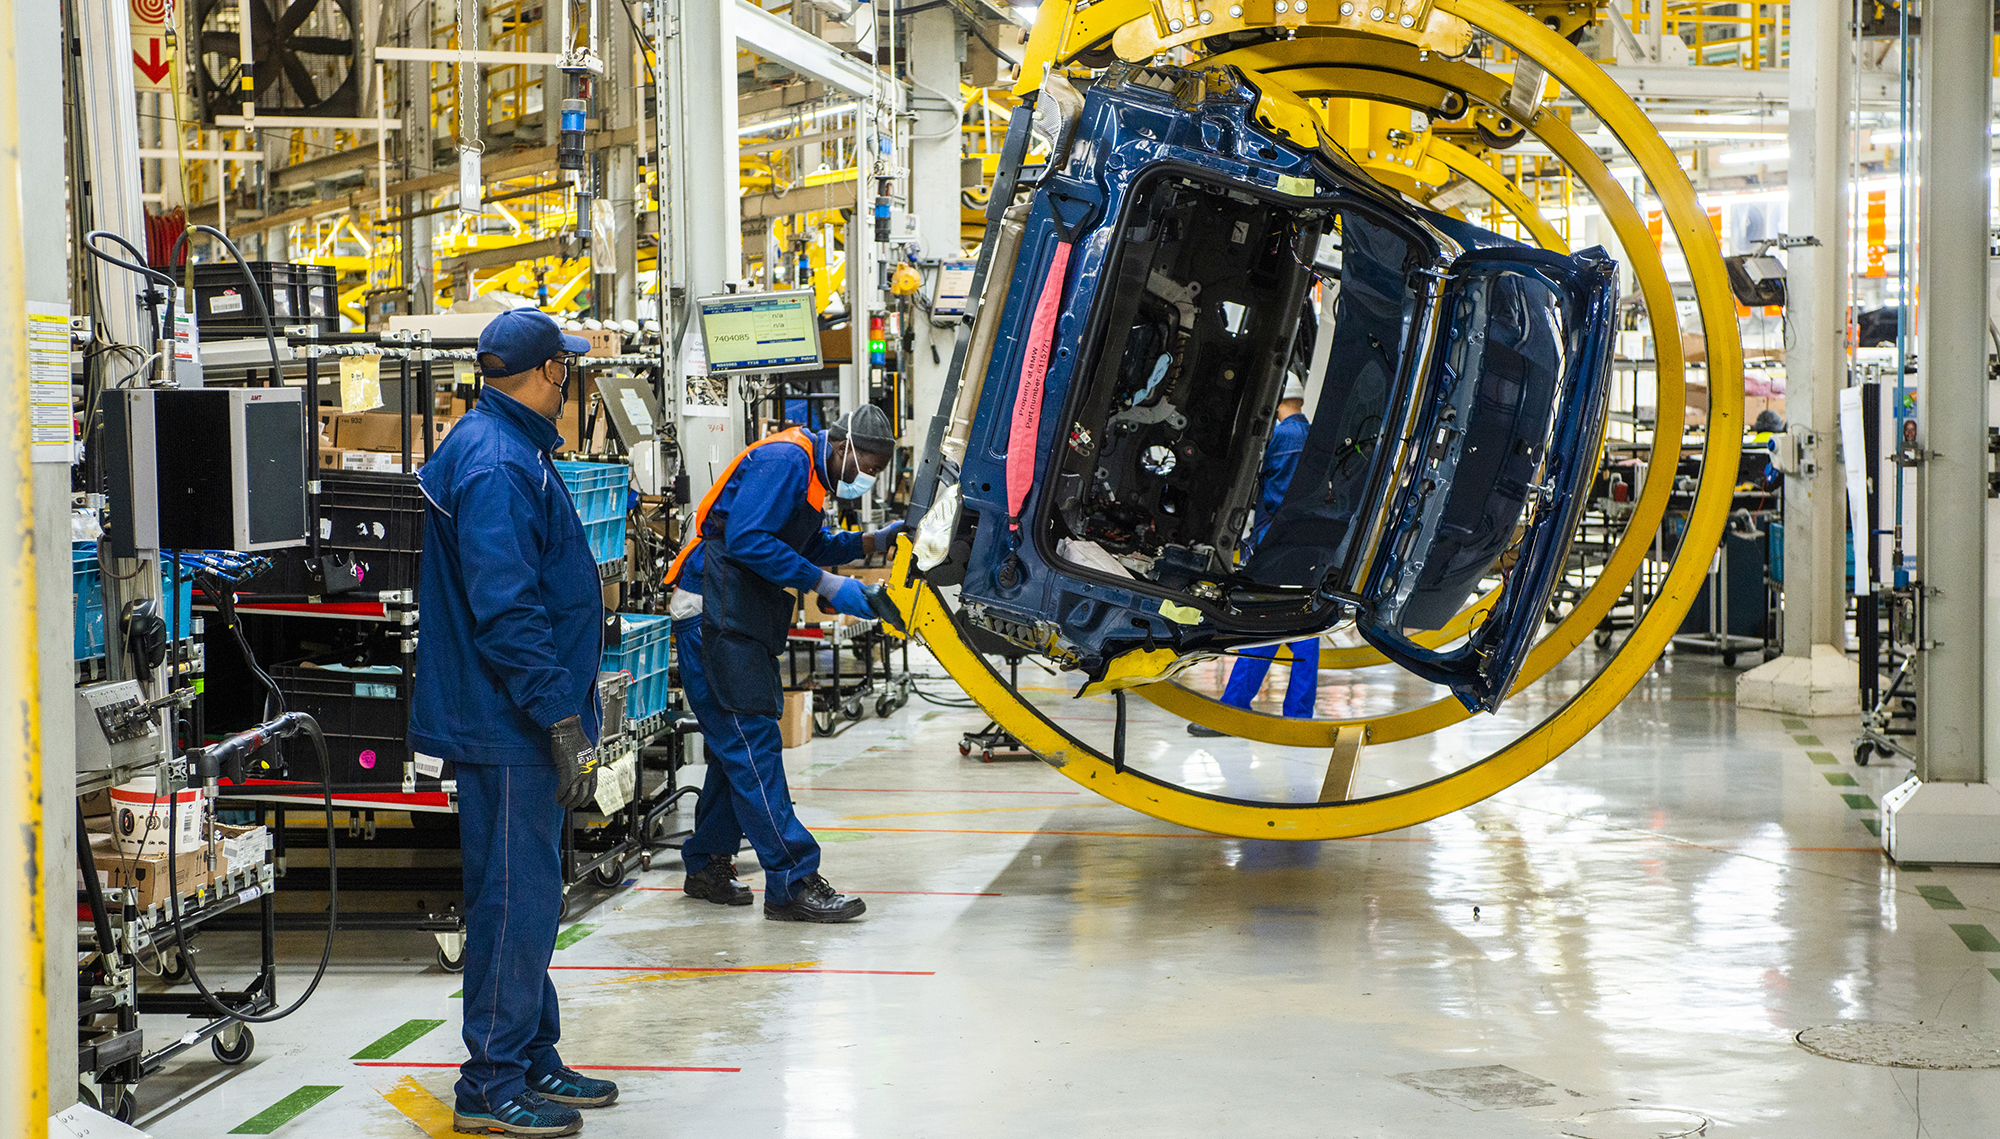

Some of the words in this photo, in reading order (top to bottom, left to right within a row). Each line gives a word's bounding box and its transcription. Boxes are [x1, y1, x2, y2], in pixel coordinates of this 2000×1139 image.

[714, 333, 750, 343] 7404085
[1029, 347, 1038, 369] BMW
[1028, 370, 1033, 379] of
[1018, 380, 1031, 416] Property
[350, 417, 363, 425] 932
[1025, 411, 1034, 429] Part
